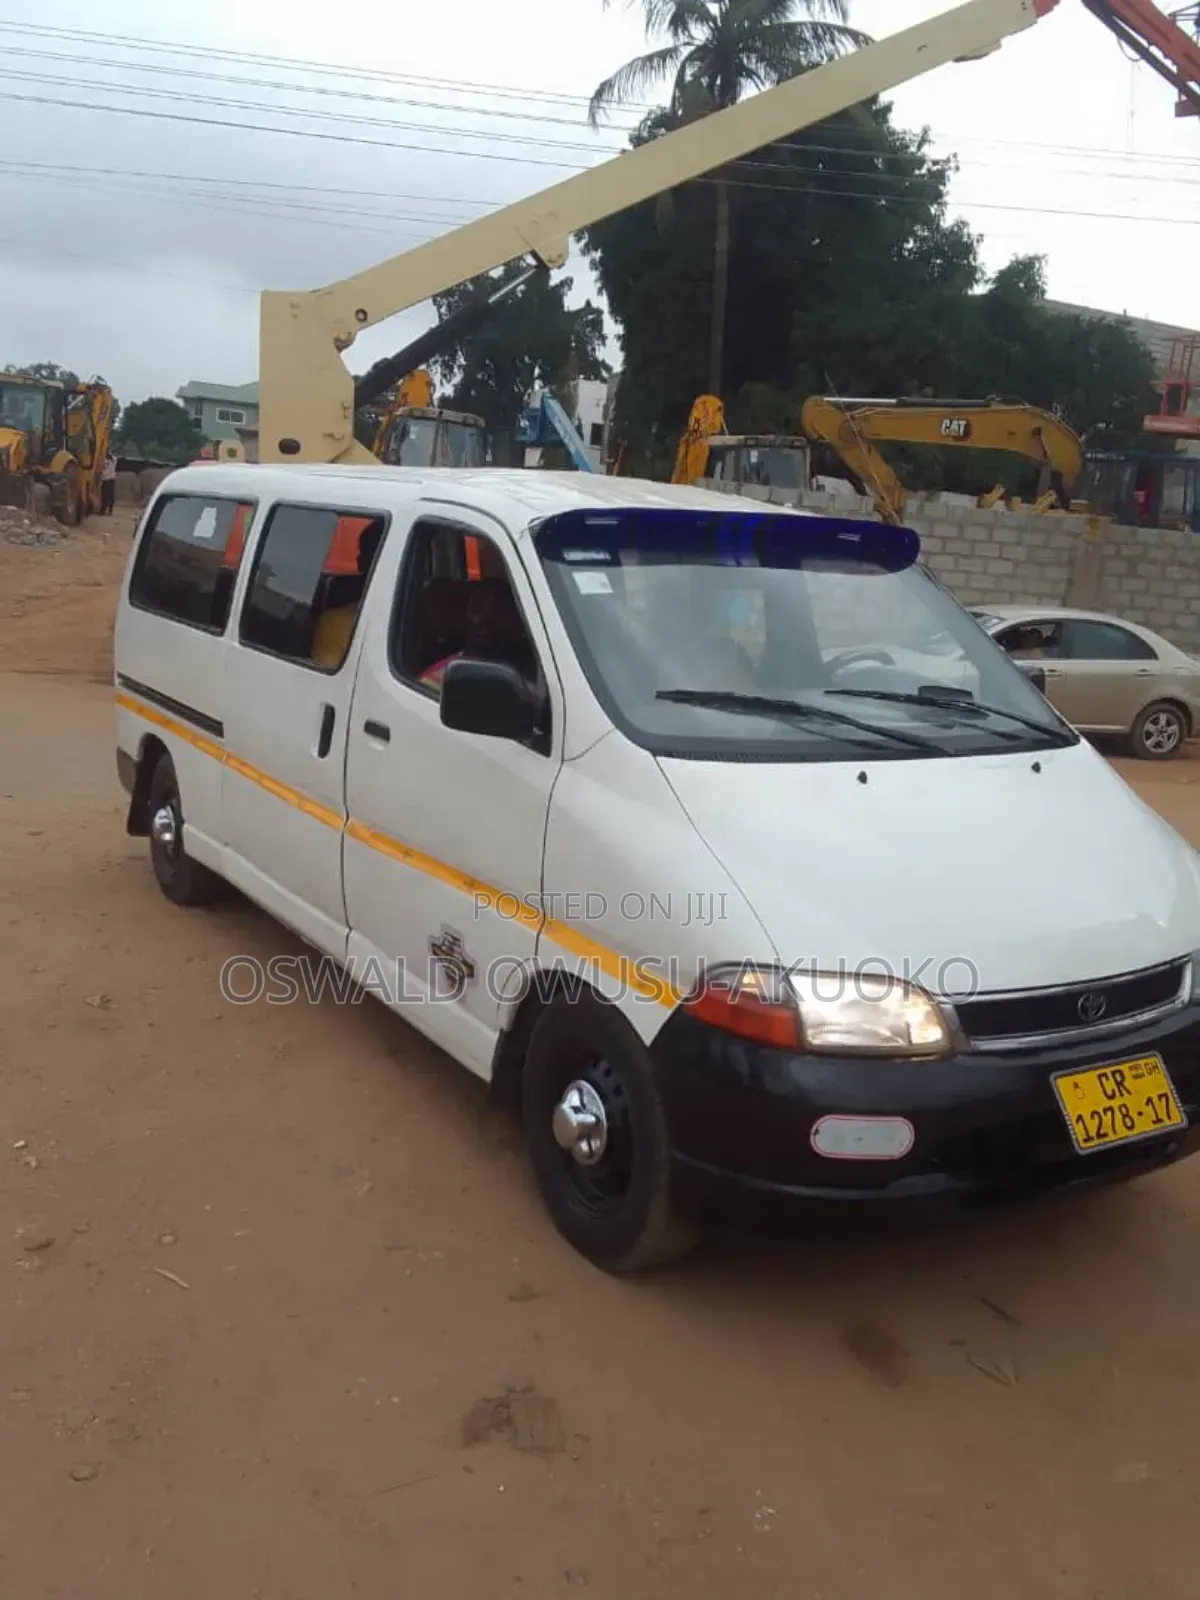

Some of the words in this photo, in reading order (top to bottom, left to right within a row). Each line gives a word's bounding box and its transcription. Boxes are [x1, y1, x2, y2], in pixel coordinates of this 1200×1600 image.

[941, 418, 967, 437] CAT
[1097, 1069, 1132, 1100] CR
[1144, 1060, 1160, 1076] GH
